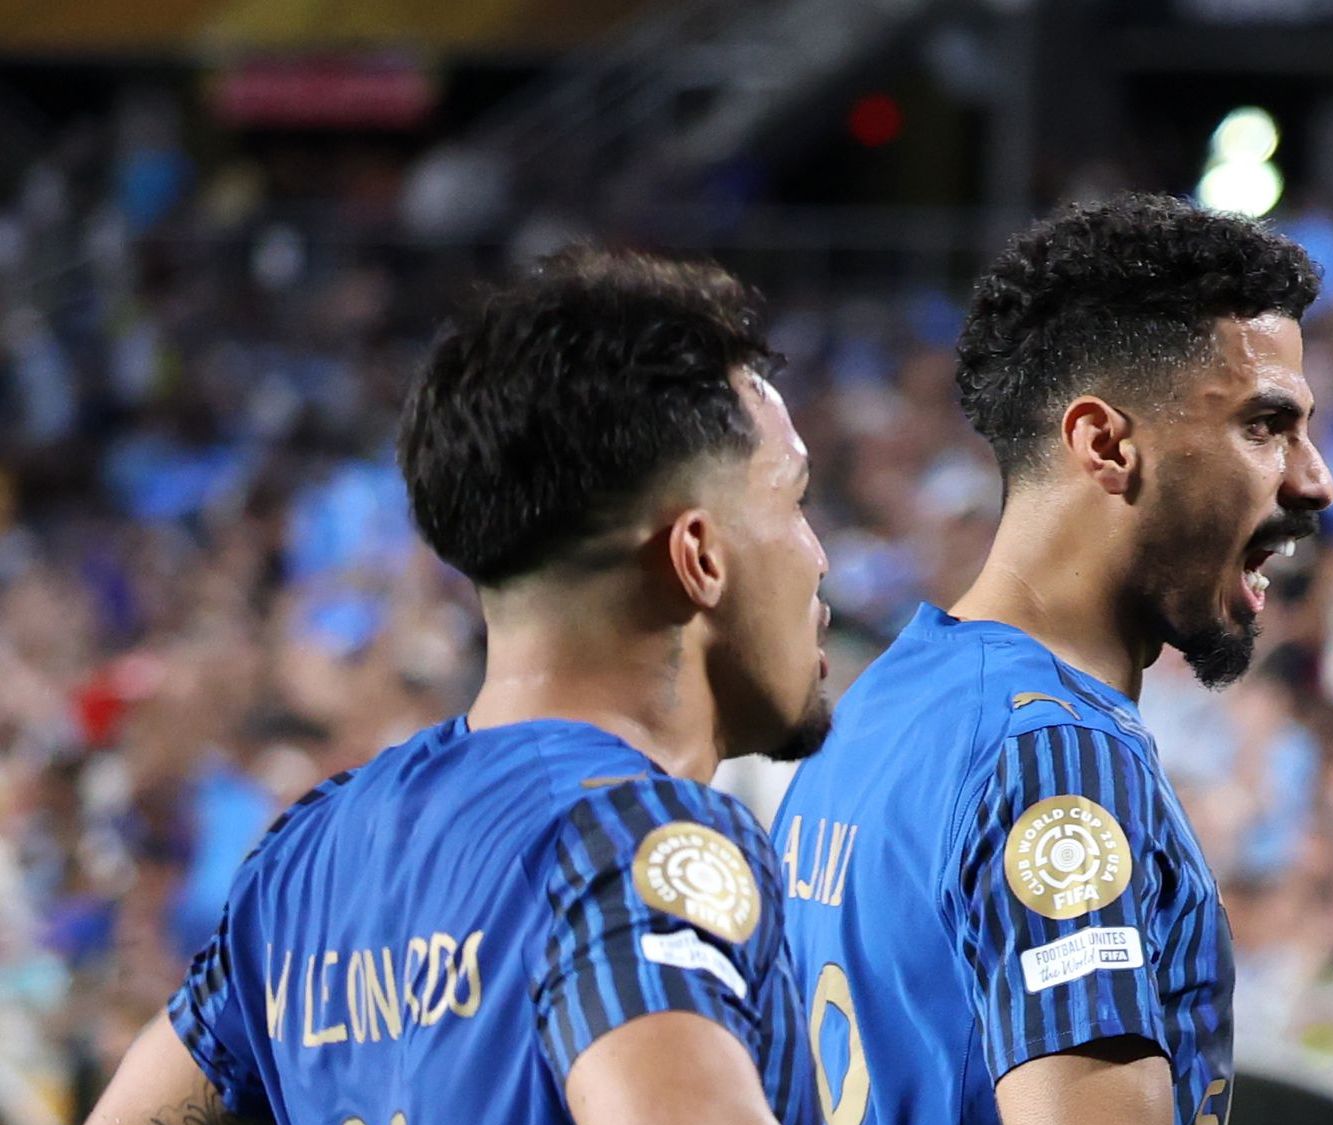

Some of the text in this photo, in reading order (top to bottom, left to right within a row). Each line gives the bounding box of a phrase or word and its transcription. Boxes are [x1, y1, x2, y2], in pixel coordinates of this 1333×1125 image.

[1018, 808, 1064, 853] WORLD
[1070, 808, 1102, 828] CUP
[1018, 859, 1045, 895] CLUB
[1100, 854, 1120, 882] USA
[1053, 884, 1100, 910] FIFA
[1036, 932, 1127, 965] FOOTBALL UNITES
[1100, 950, 1128, 962] FIFA
